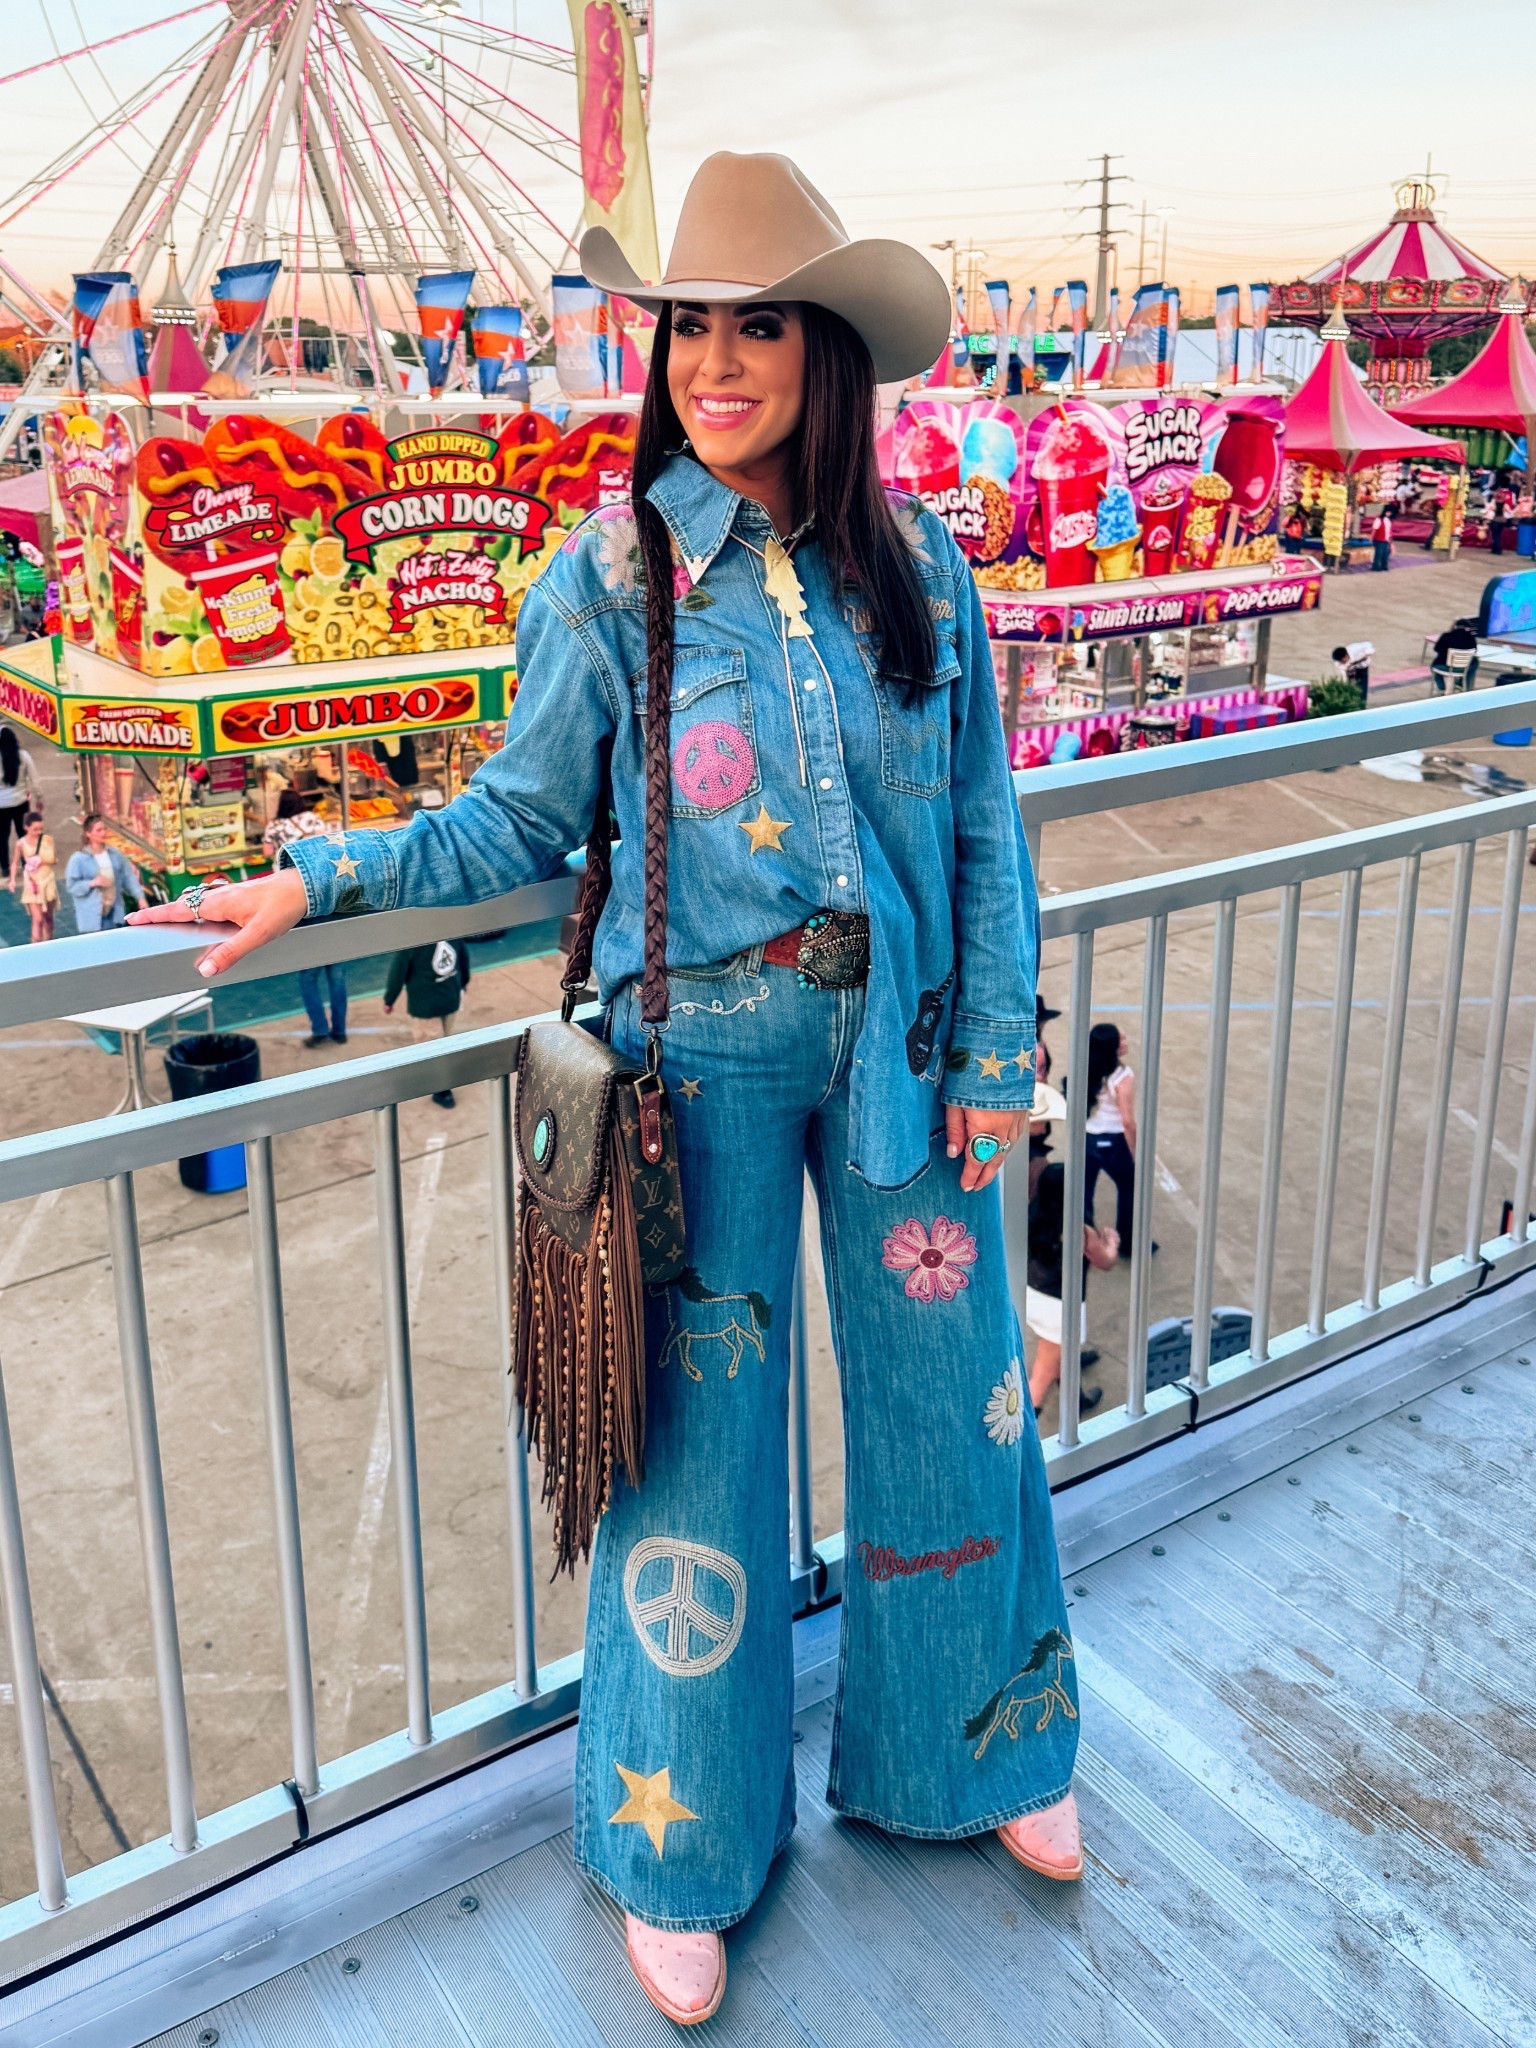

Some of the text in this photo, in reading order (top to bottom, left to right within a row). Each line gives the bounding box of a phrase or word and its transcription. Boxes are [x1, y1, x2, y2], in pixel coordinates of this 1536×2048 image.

[1125, 406, 1201, 450] SUGAR
[396, 434, 491, 459] HAND DIPPED
[1126, 435, 1202, 480] SHACK
[389, 460, 497, 491] JUMBO
[192, 483, 253, 516] Cherry
[361, 492, 530, 536] CORN DOGS
[920, 486, 985, 515] SUGAR
[170, 502, 273, 542] LIMEADE
[939, 511, 987, 538] ACK
[400, 553, 441, 587] Hot
[446, 549, 497, 584] Zesty
[399, 582, 497, 610] NACHOS
[1223, 585, 1305, 614] POPCORN
[226, 602, 273, 622] Fresh
[995, 608, 1036, 622] SUGAR
[995, 619, 1036, 635] SHACK
[1088, 600, 1185, 631] SHAVED ICE & SODA
[262, 686, 442, 737] JUMBO
[73, 720, 193, 748] LEMONADE
[858, 1536, 1002, 1581] Wrangler
